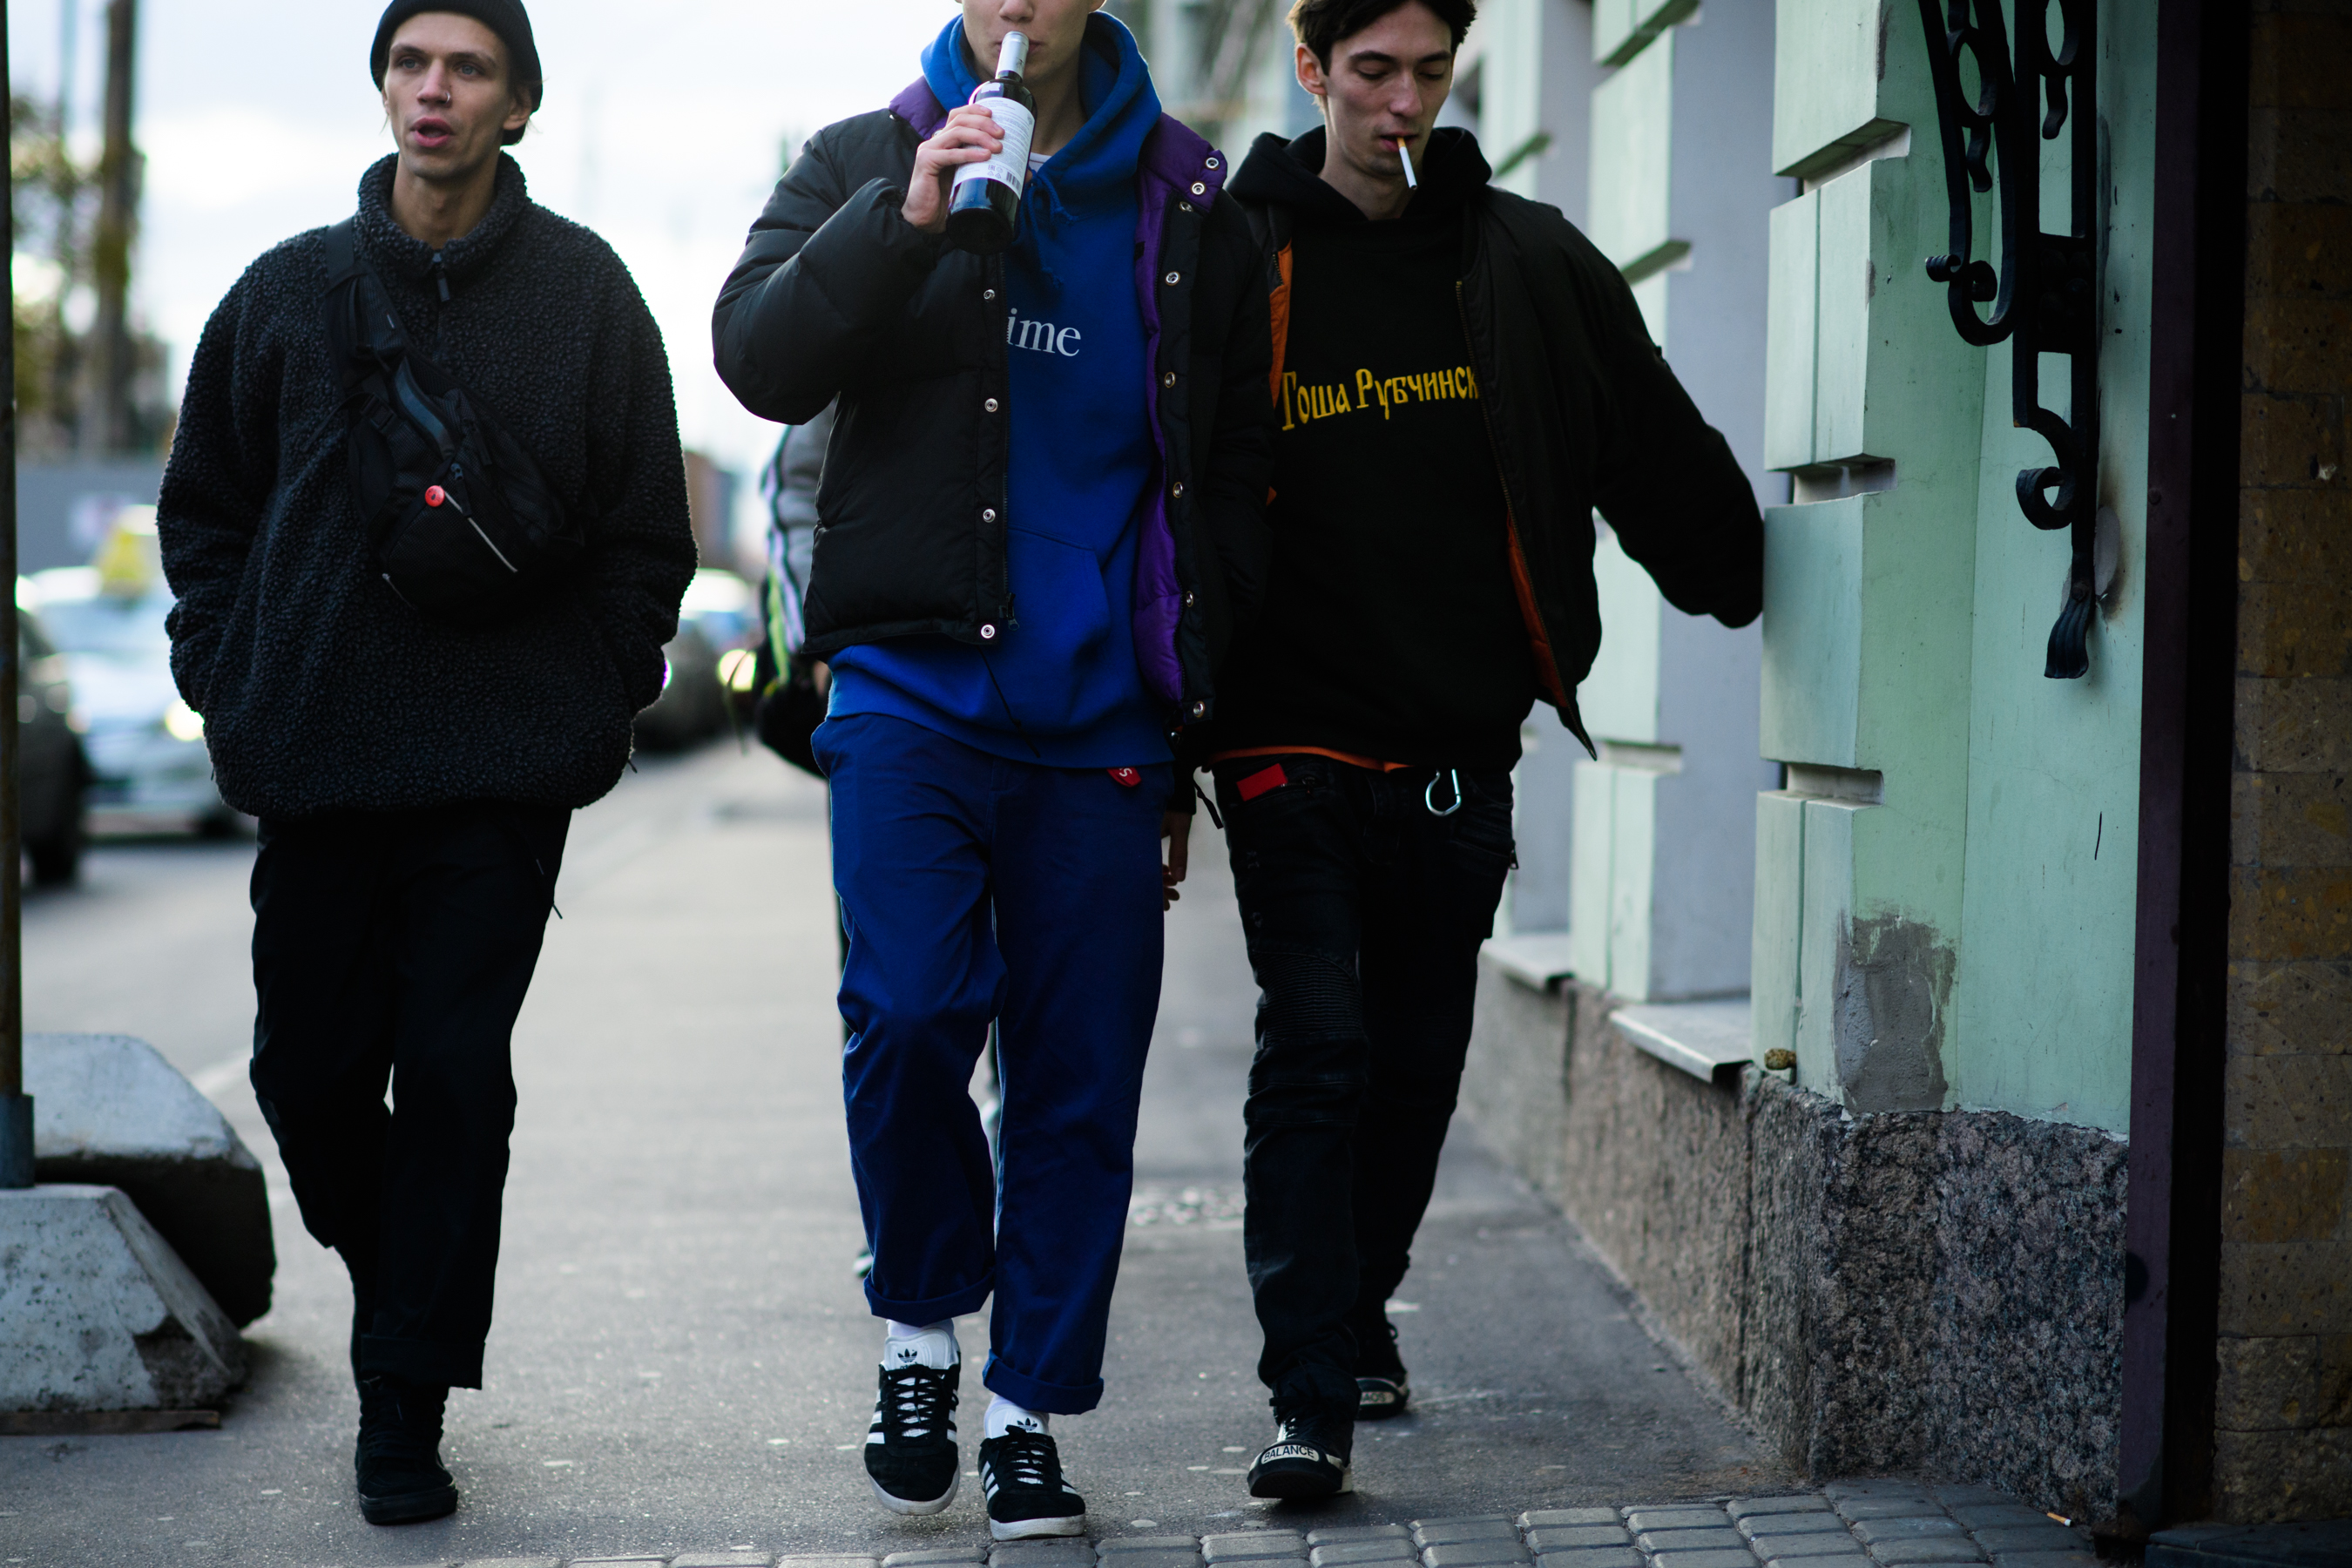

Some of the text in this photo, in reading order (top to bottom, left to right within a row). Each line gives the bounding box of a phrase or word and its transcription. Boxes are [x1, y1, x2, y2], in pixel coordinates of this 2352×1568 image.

[1006, 308, 1081, 356] ime
[1281, 370, 1351, 431] Гоша
[1263, 1444, 1315, 1462] BALANCE
